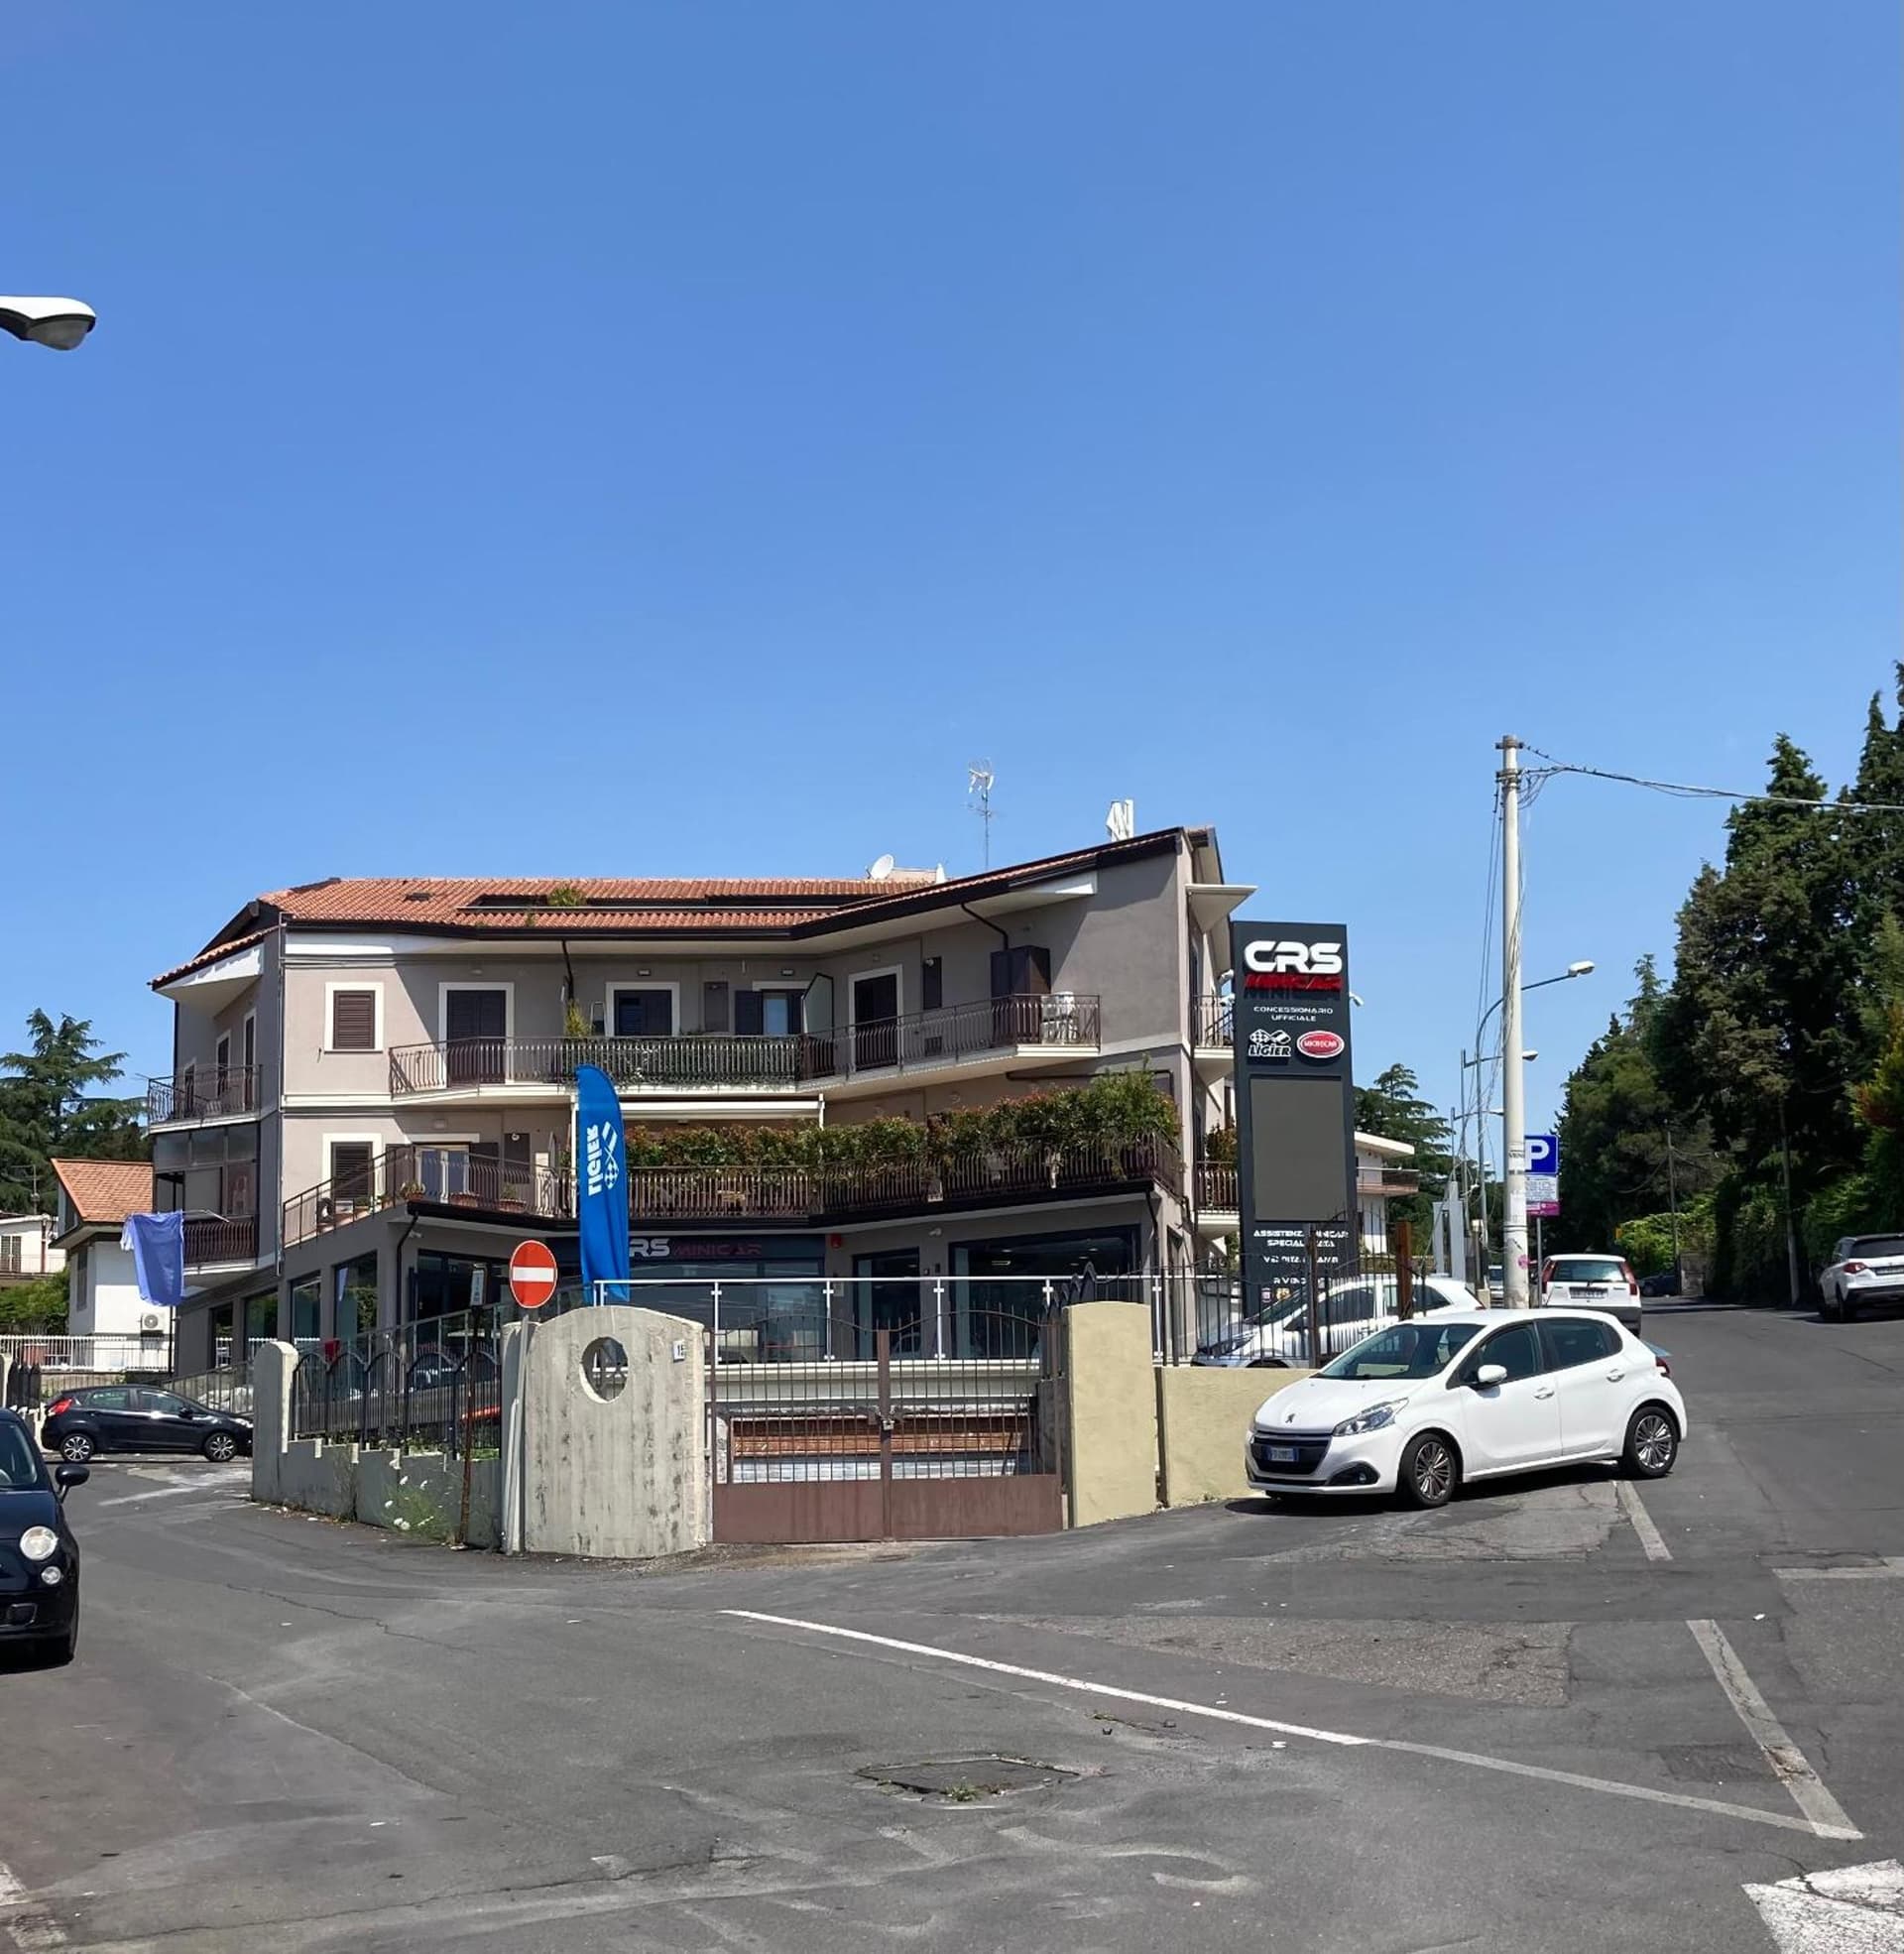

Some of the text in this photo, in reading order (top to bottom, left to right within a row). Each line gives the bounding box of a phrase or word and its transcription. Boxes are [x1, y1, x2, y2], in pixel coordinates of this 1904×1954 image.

[1245, 940, 1343, 974] CRS
[1252, 1006, 1334, 1015] CONCESSIONARIO
[1525, 1139, 1550, 1170] P
[628, 1238, 762, 1258] RS MINICAR
